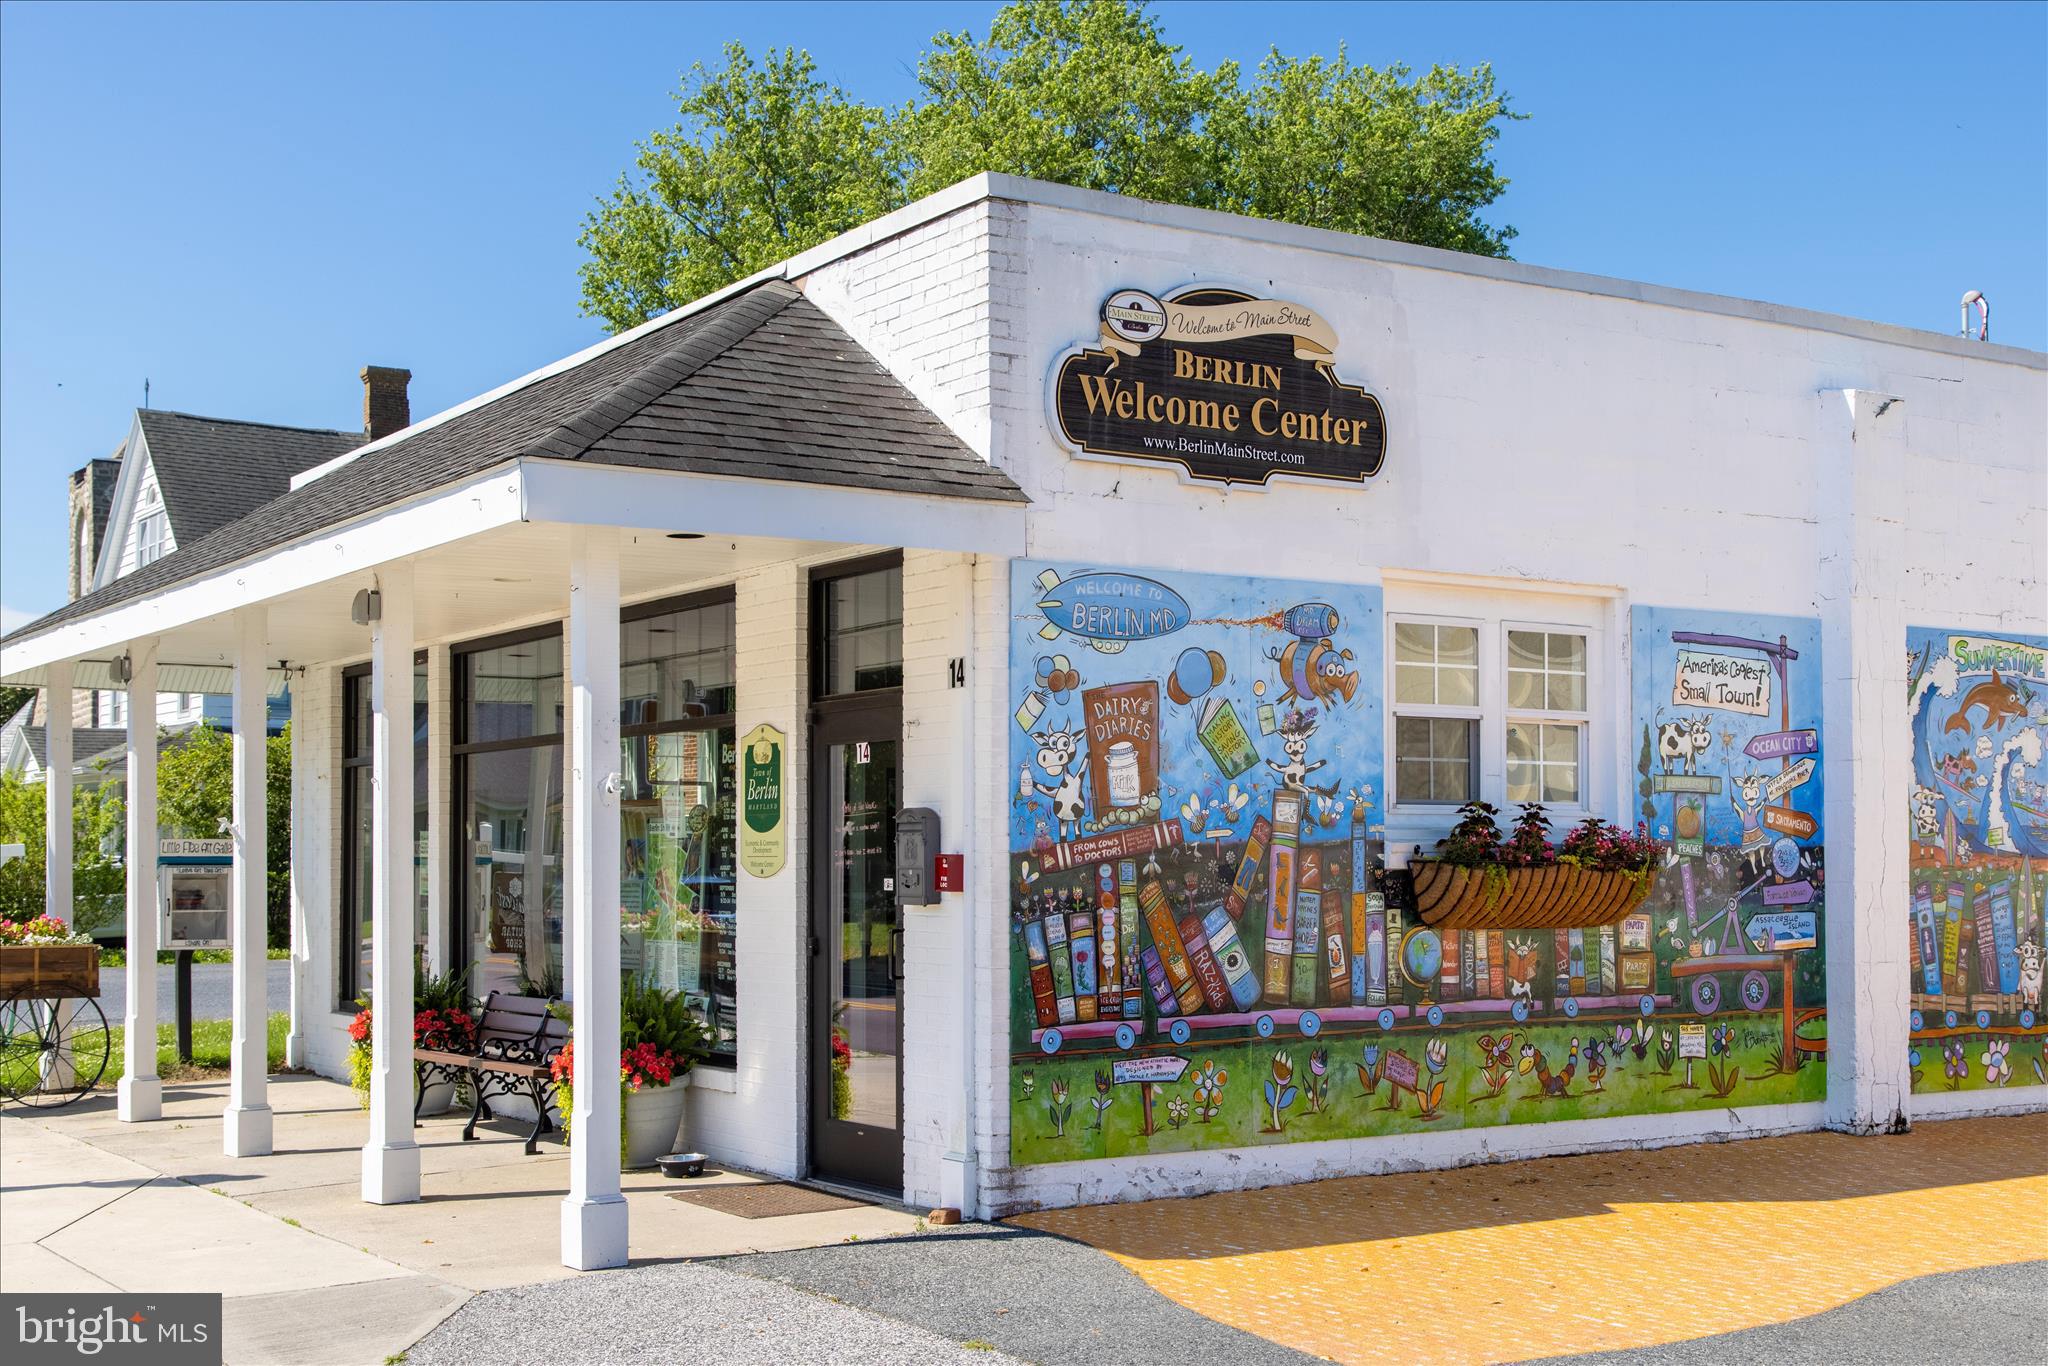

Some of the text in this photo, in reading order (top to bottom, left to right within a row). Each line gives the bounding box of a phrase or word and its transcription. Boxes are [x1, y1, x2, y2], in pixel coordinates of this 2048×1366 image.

[1171, 306, 1313, 335] Welcome to Main Street
[1174, 349, 1283, 391] BERLIN
[1077, 373, 1368, 447] Welcome Center
[1143, 435, 1305, 465] www.BerlinMainStreet.com
[1075, 583, 1163, 601] WELCOME TO
[1955, 639, 2046, 675] SUMMERTIME
[949, 658, 965, 688] 14
[1682, 656, 1766, 685] America's Coolest
[1680, 679, 1762, 707] Small Town!
[1093, 697, 1142, 719] DAIRY
[1095, 717, 1151, 742] DIARIES
[858, 744, 870, 762] 14
[1752, 736, 1802, 754] OCEAN CITY
[747, 777, 779, 801] Berlin
[162, 841, 181, 854] Little
[1073, 842, 1097, 854] FROM
[1098, 837, 1120, 850] COWS
[1084, 847, 1122, 860] DOCTORS
[1678, 843, 1703, 857] PEACHES
[1122, 924, 1135, 935] Did
[1625, 920, 1645, 930] PARTS
[1465, 943, 1475, 990] FRIDAY
[1626, 961, 1648, 973] PARTS
